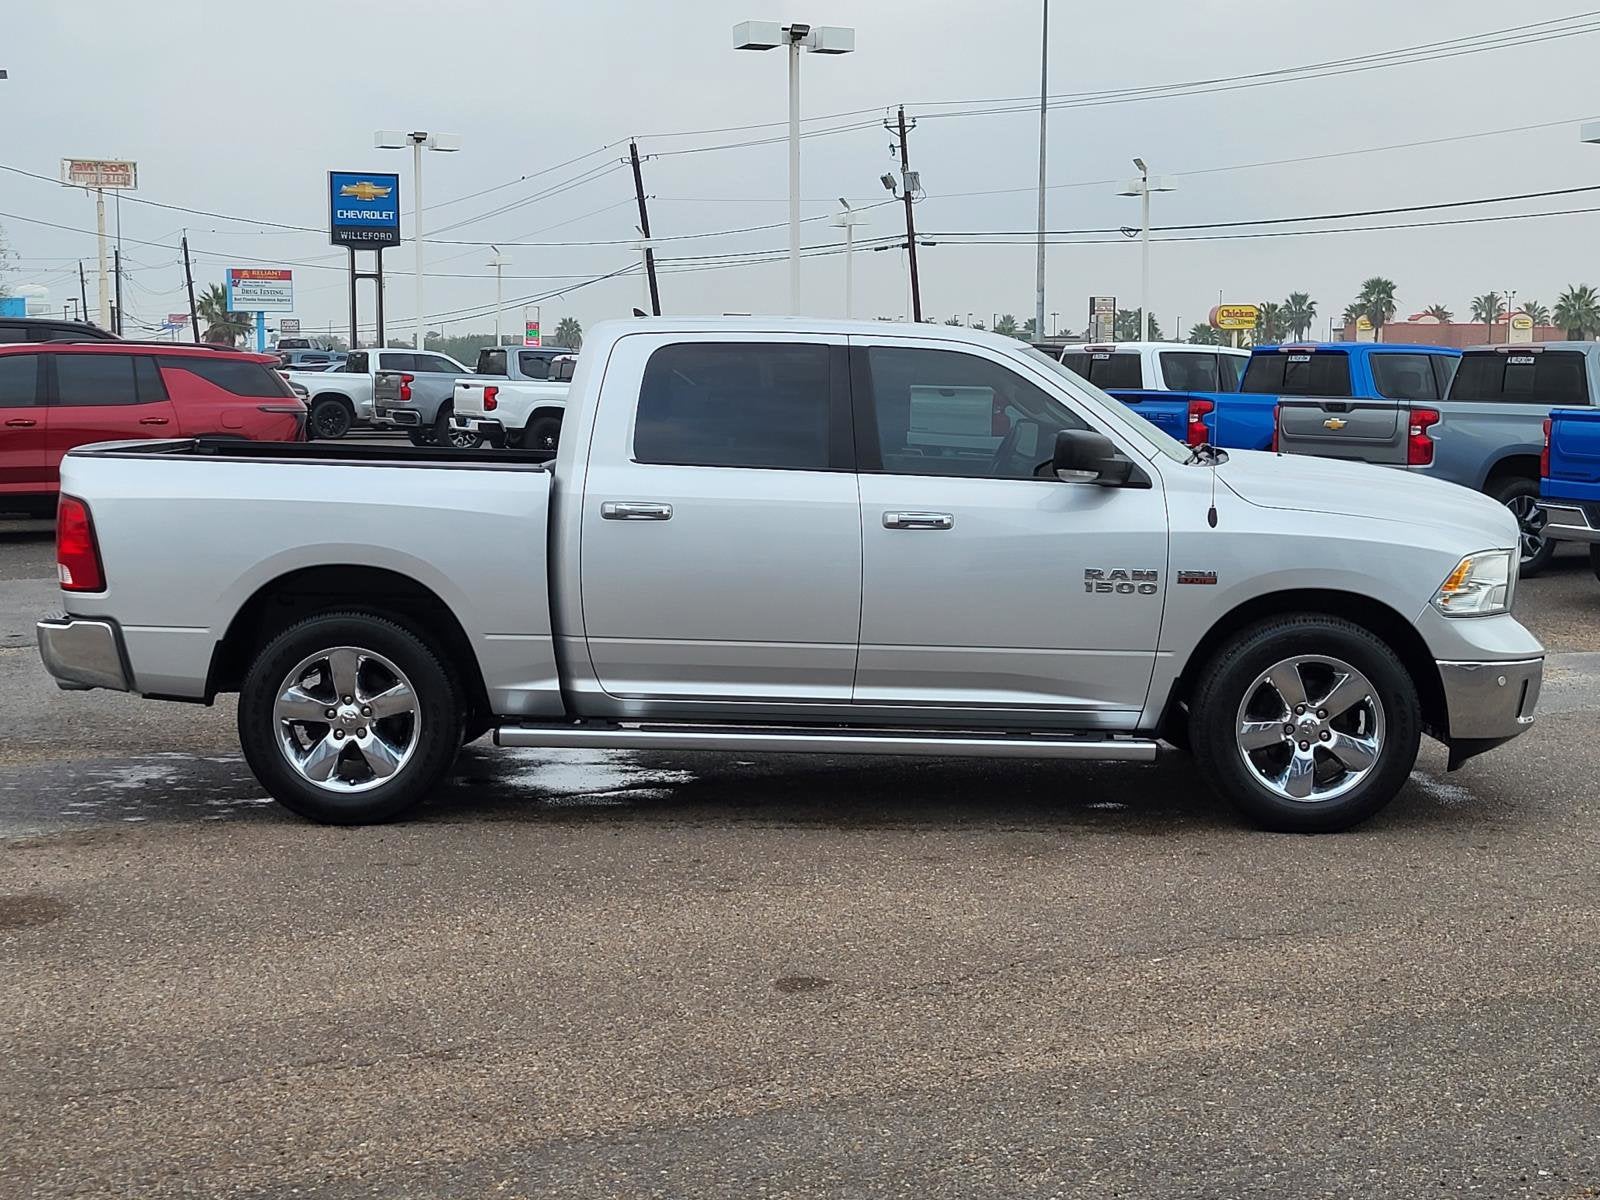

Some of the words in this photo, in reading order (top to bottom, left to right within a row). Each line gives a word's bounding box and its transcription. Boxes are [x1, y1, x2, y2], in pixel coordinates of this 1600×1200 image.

[337, 209, 394, 219] CHEVROLET
[340, 231, 392, 240] WILLEFORD
[1221, 309, 1254, 318] Chicken
[1084, 568, 1158, 581] RAM
[1084, 581, 1158, 594] 1500
